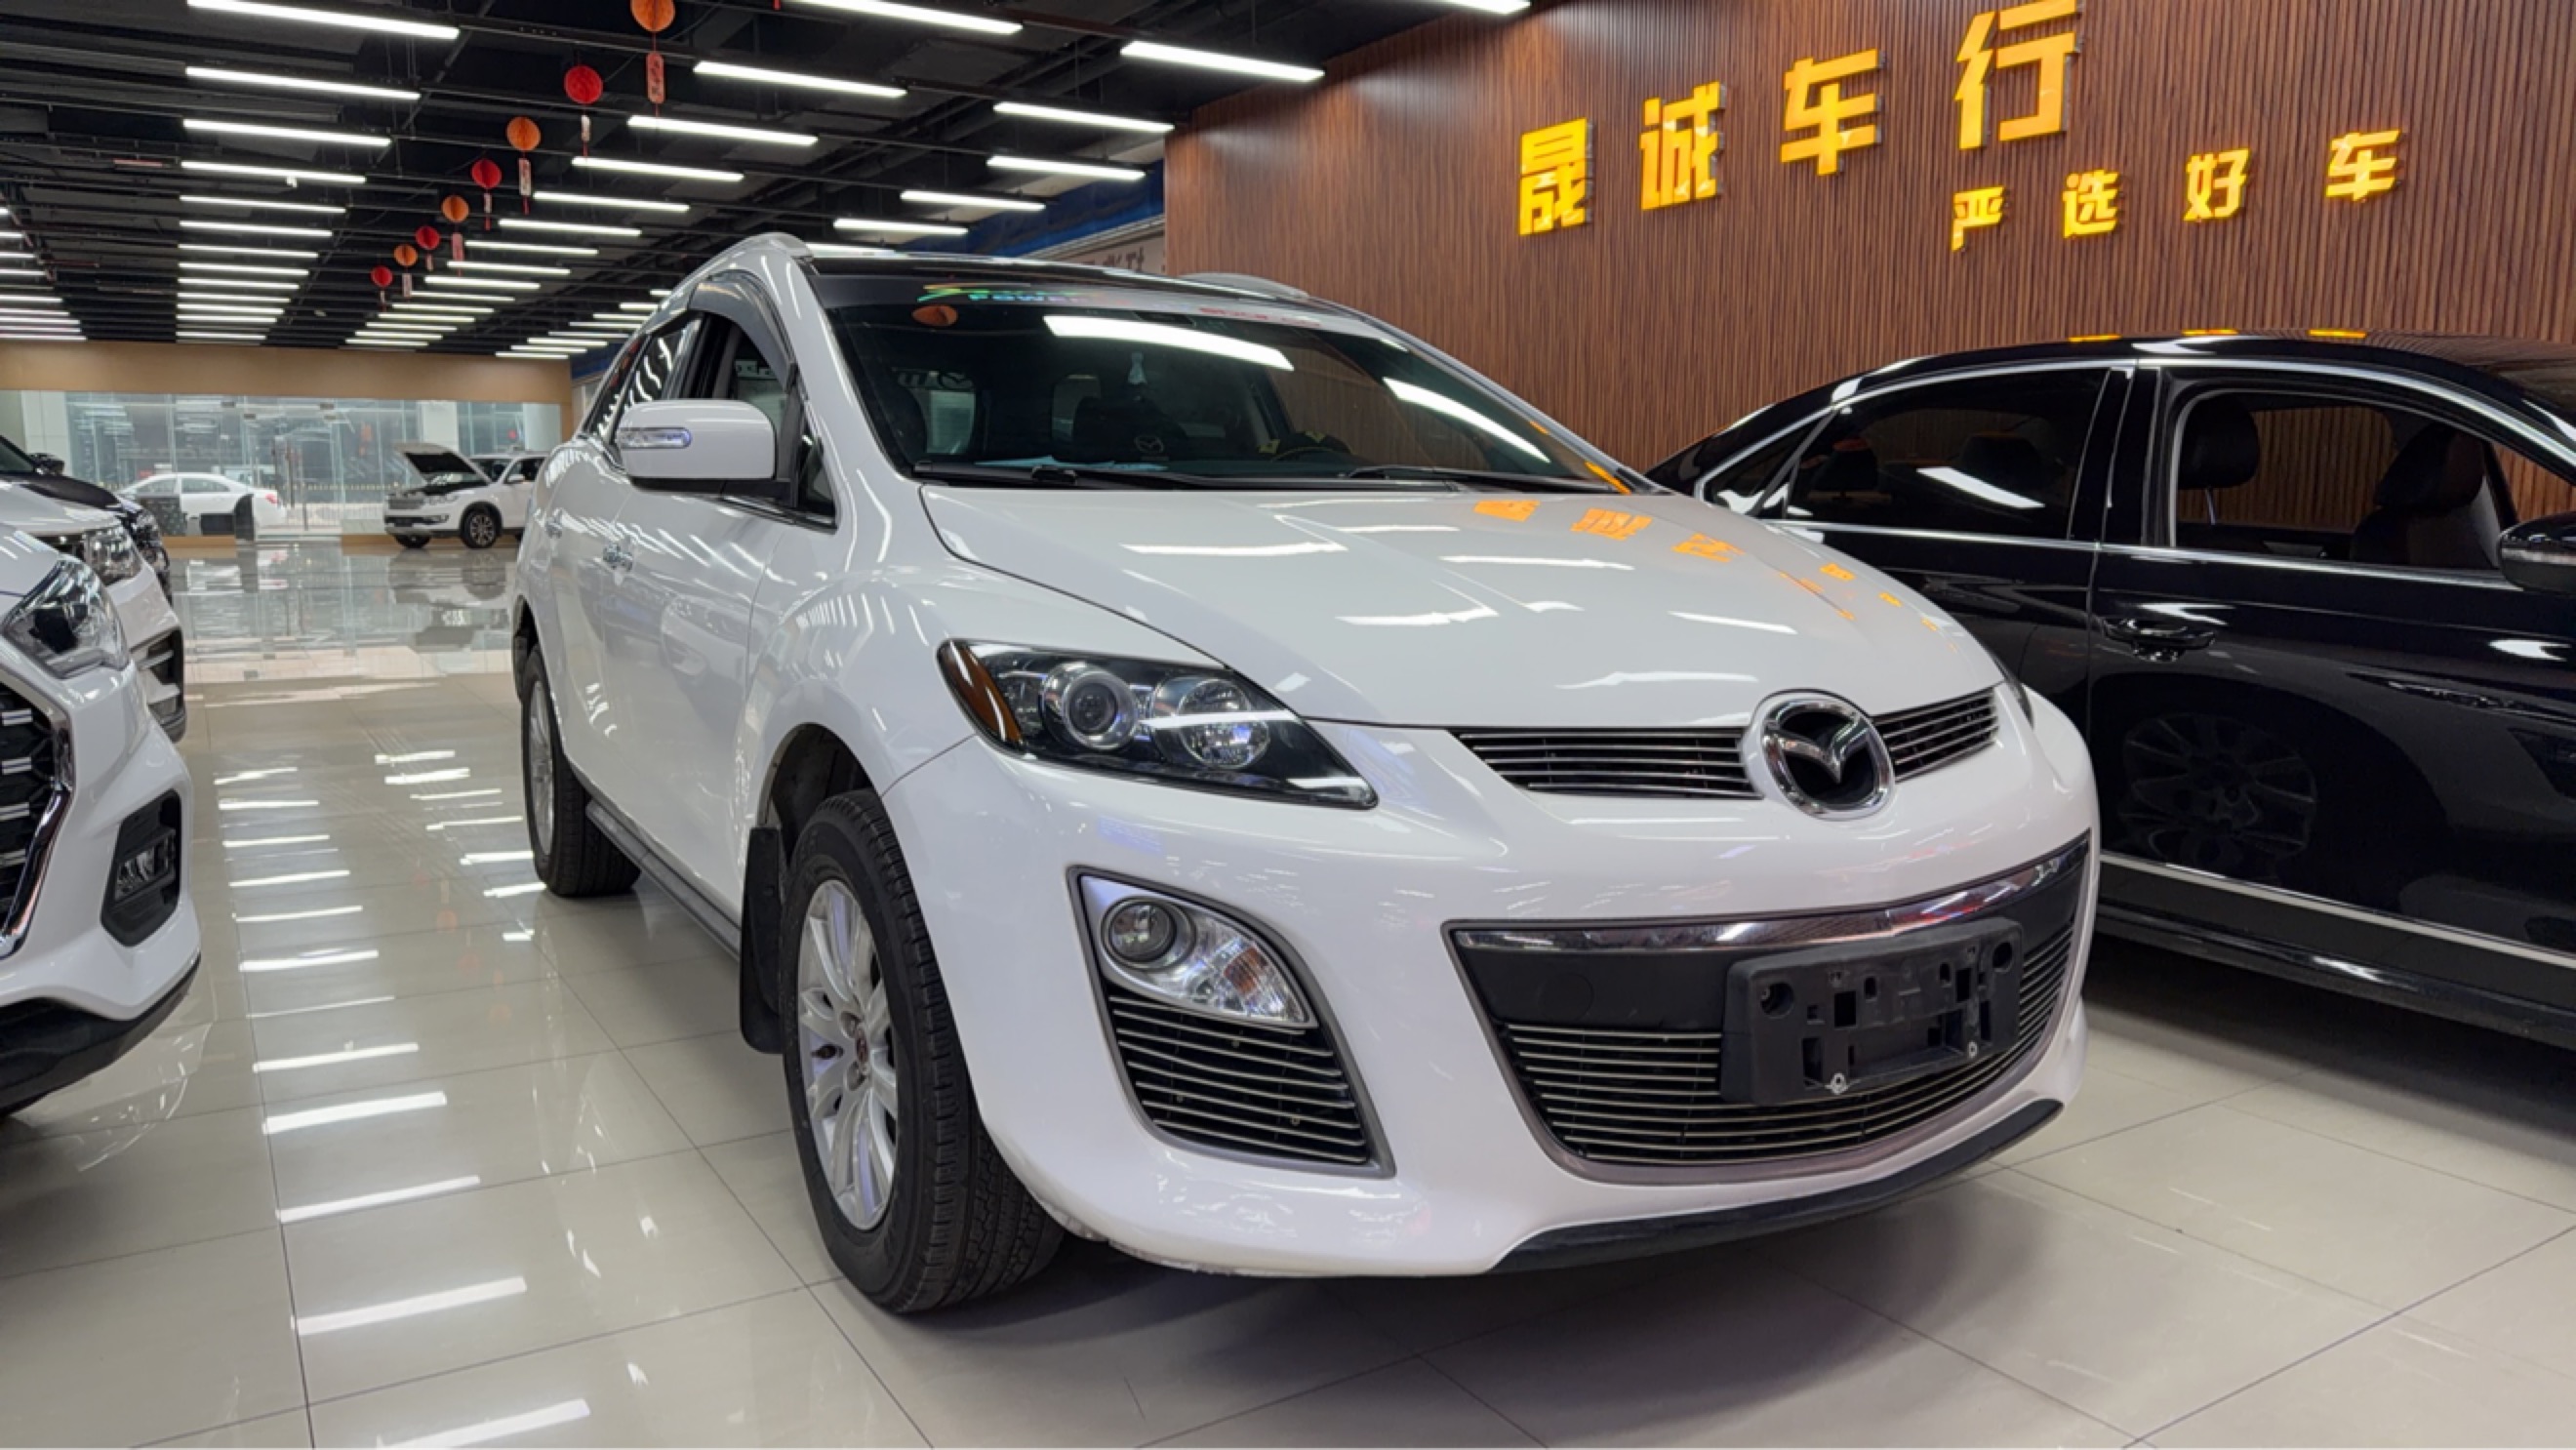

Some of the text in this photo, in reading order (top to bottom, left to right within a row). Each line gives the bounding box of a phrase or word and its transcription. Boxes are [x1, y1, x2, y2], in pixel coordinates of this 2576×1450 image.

[1518, 0, 2081, 236] 晟诚车行
[1950, 129, 2402, 252] 严选好车
